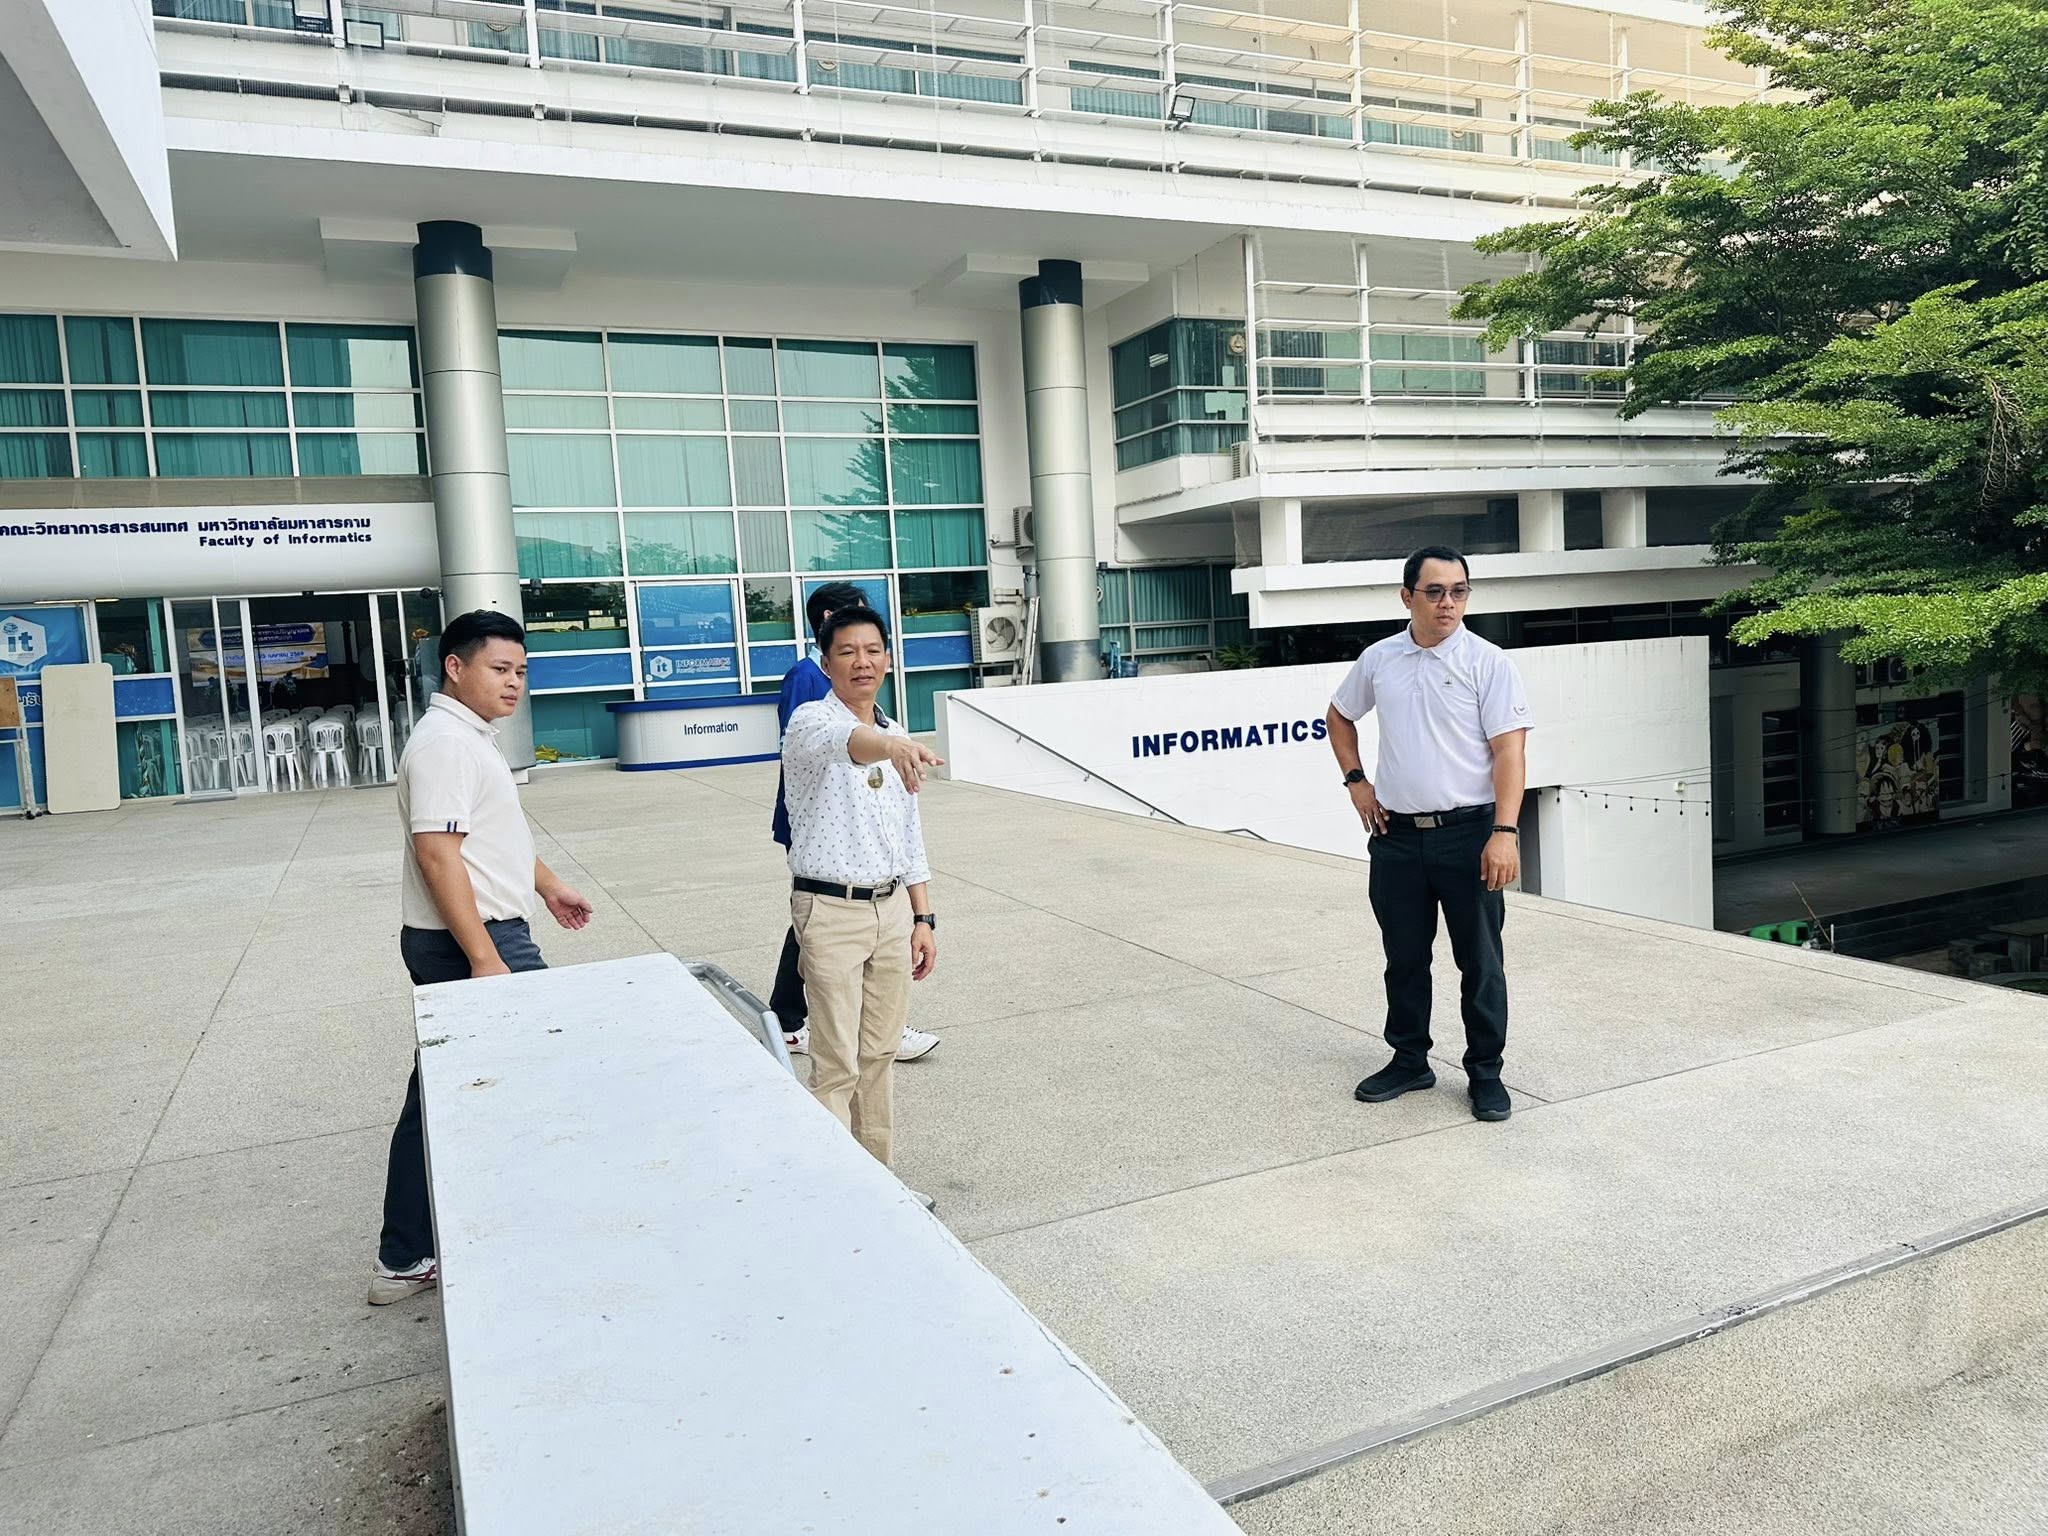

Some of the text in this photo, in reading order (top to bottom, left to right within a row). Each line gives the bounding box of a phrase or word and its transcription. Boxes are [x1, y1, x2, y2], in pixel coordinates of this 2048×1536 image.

[0, 516, 371, 537] คณะวิทยาการสารสนเทศ มหาวิทยาลัยมหาสารคาม
[199, 532, 372, 547] Faculty of Informatics
[8, 631, 34, 653] it
[684, 721, 739, 736] Information
[1132, 718, 1328, 758] INFORMATICS
